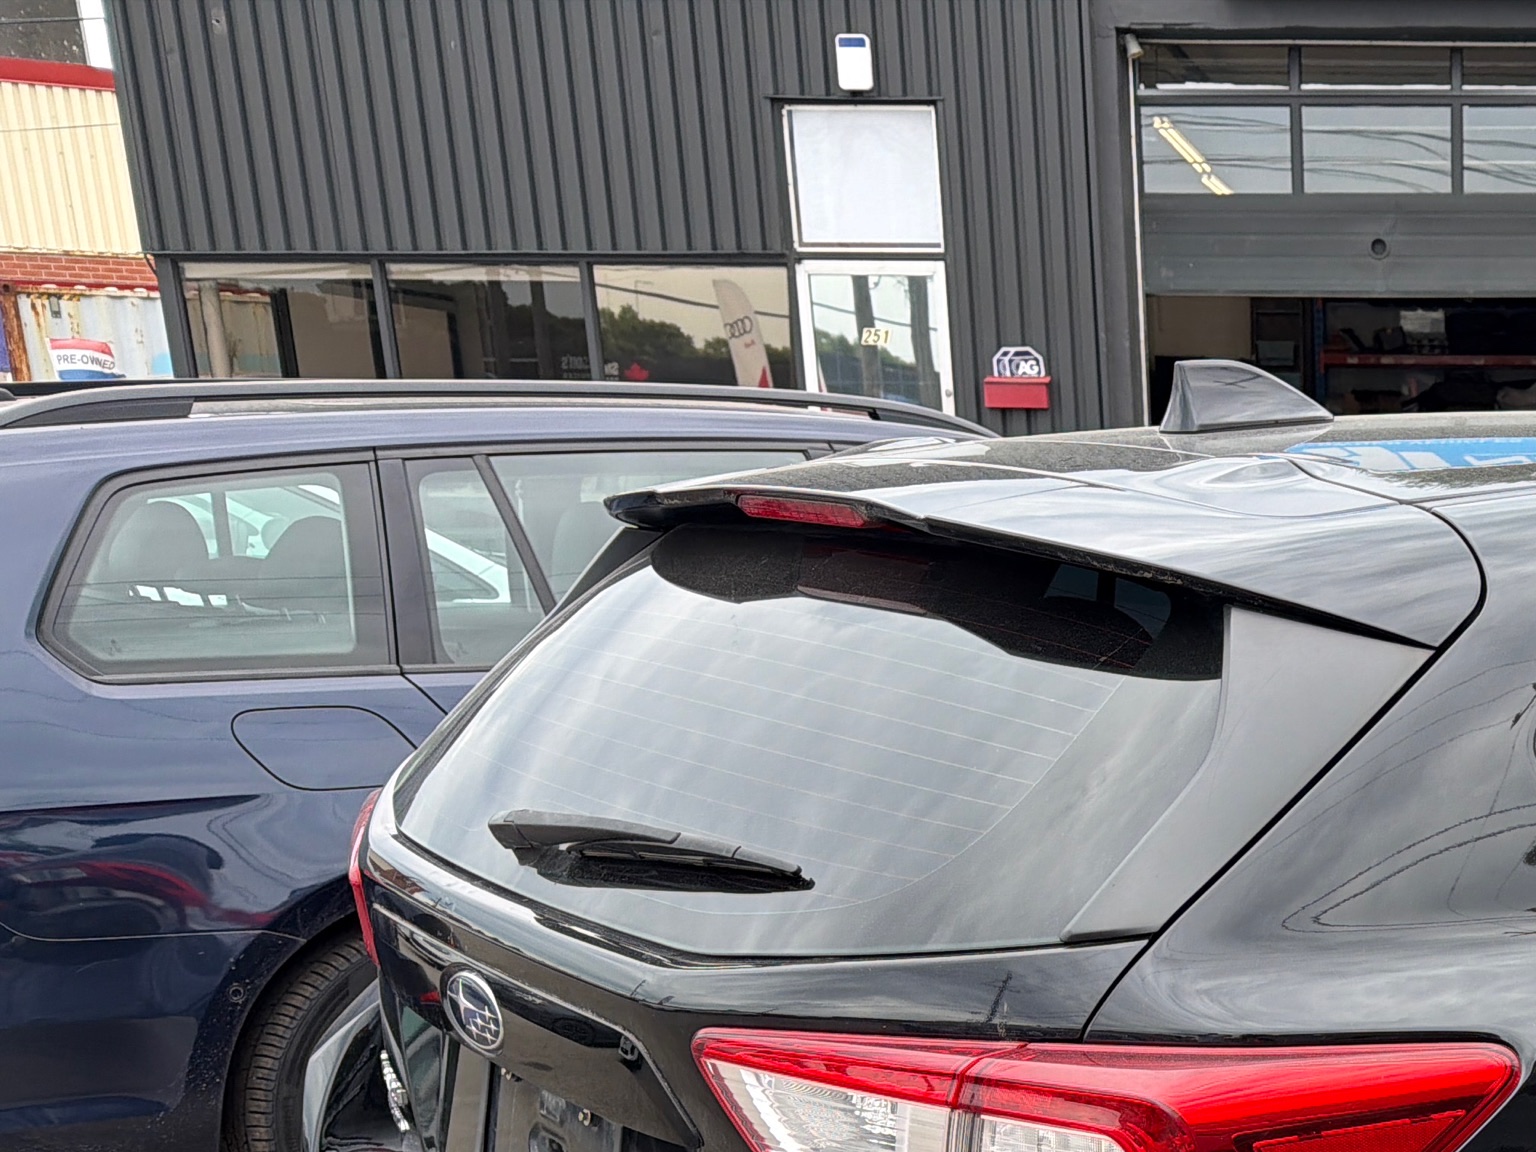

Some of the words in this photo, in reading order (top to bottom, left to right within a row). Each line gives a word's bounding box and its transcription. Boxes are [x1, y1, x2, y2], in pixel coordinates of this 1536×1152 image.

[863, 329, 890, 344] 251
[56, 354, 116, 370] PRE-OWNED
[1018, 360, 1040, 376] AG
